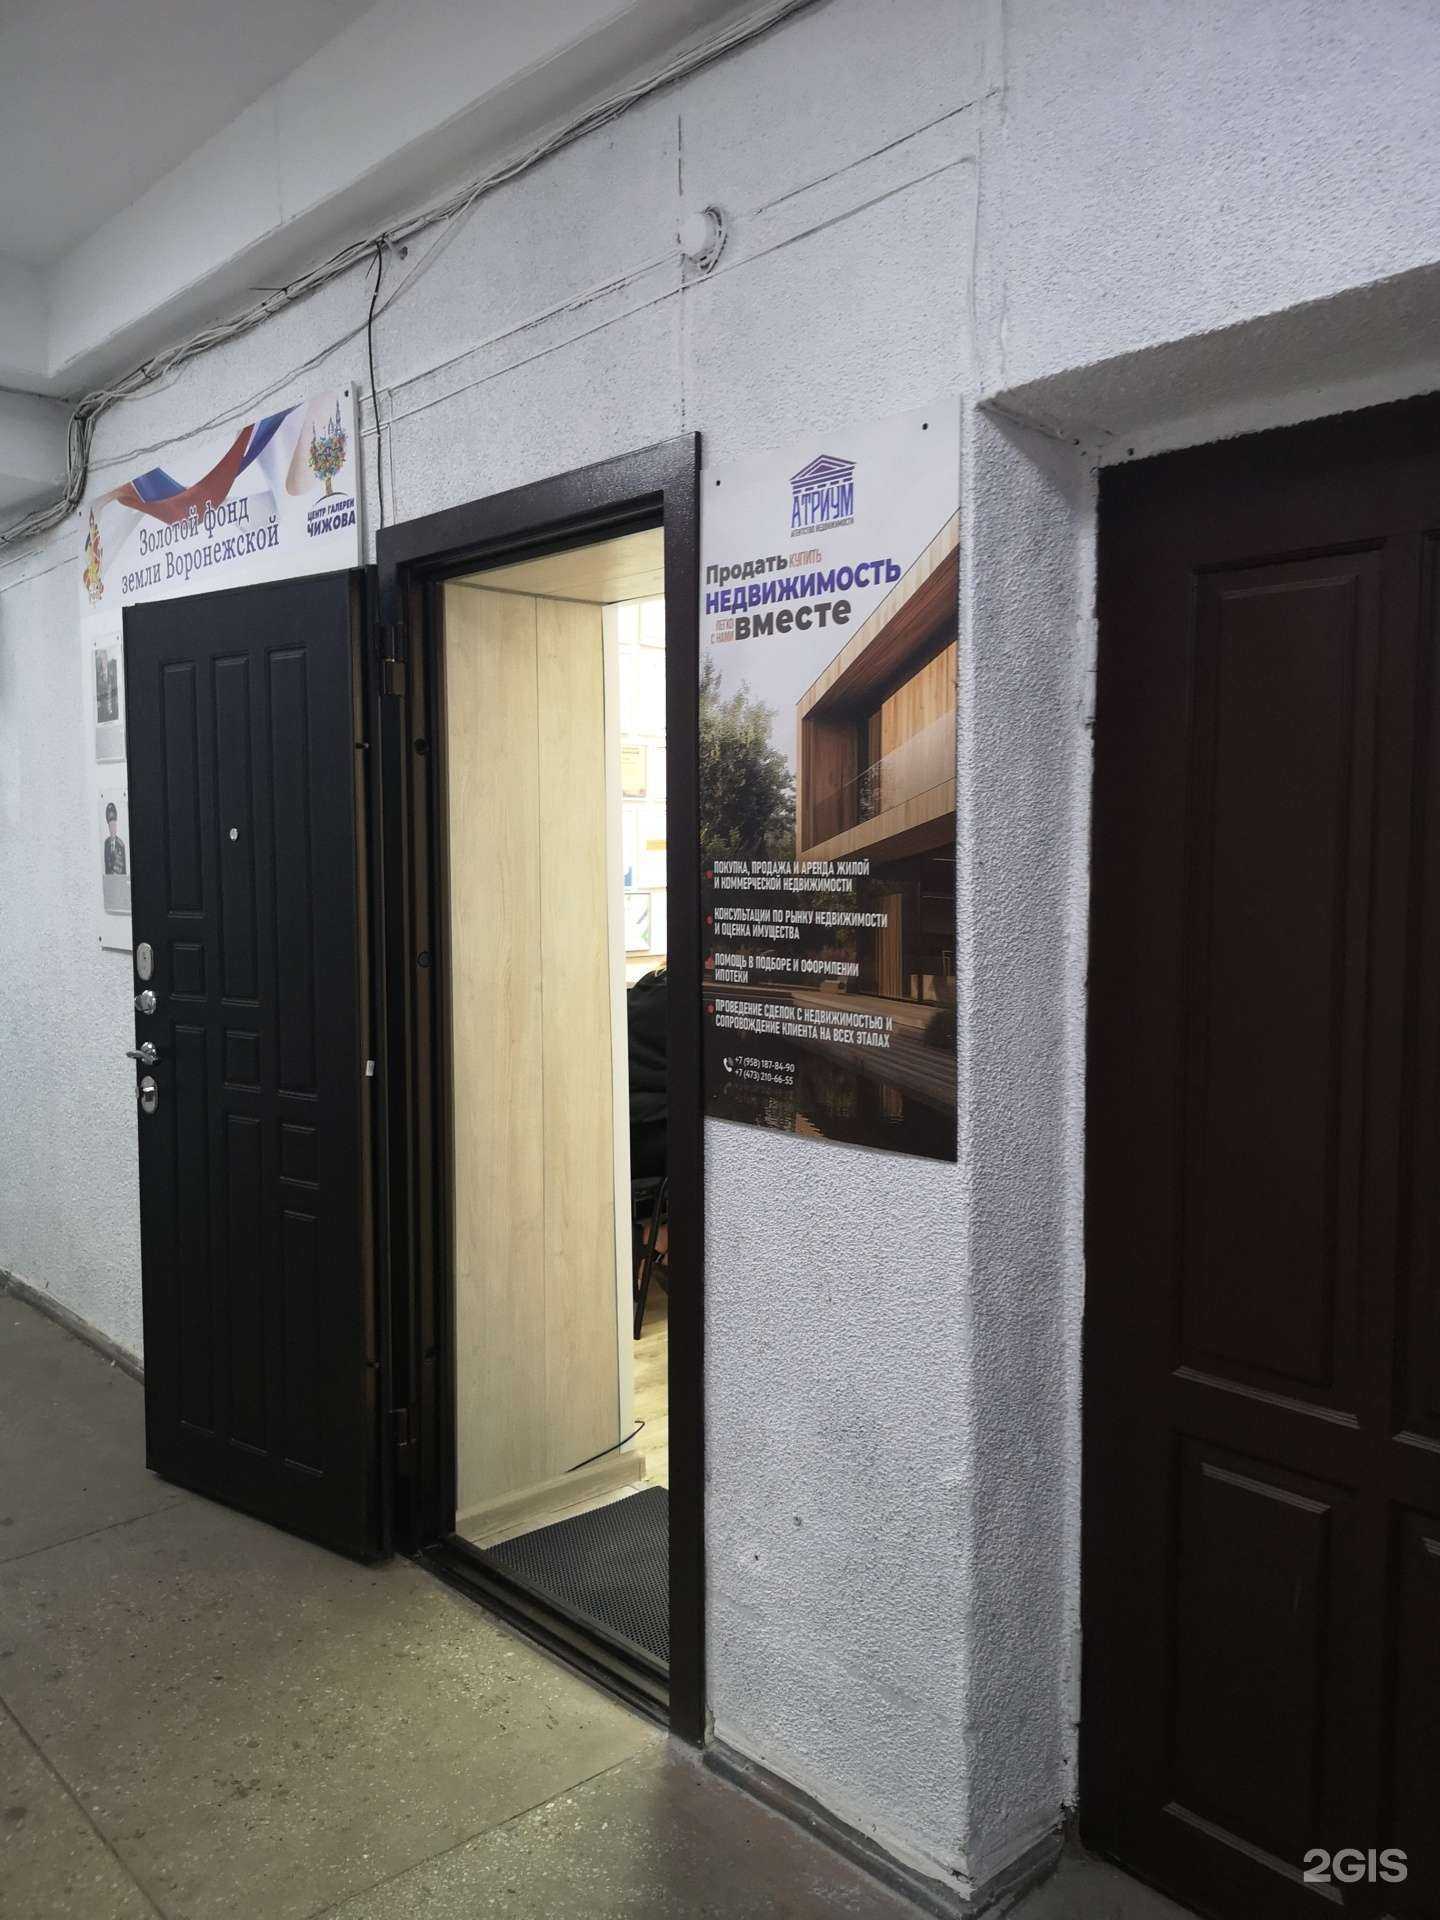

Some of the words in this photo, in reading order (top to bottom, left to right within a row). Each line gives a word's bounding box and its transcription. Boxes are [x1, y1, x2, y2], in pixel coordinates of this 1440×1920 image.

[790, 482, 854, 529] АТРИУМ
[139, 508, 199, 556] Золотой
[203, 497, 249, 540] фонд
[307, 510, 356, 537] ЧИЖОВА
[121, 562, 161, 594] земли
[166, 515, 280, 579] Воронежской
[706, 555, 788, 587] Продать
[789, 549, 822, 568] КУПИТЬ
[705, 558, 902, 614] НЕДВИЖИМОСТЬ
[735, 599, 852, 640] вместе
[714, 860, 750, 876] ПОКУПКА,
[751, 861, 791, 876] ПРОДАЖА
[793, 861, 800, 874] И
[801, 861, 834, 877] АРЕНДА
[836, 859, 870, 876] ЖИЛОЙ
[714, 876, 720, 889] И
[721, 875, 781, 890] КОММЕРЧЕСКОЙ
[783, 877, 853, 892] НЕДВИЖИМОСТИ
[714, 907, 771, 923] КОНСУЛЬТАЦИИ
[773, 909, 783, 922] ПО
[785, 910, 813, 924] РЫНКУ
[815, 911, 888, 928] НЕДВИЖИМОСТИ
[714, 922, 720, 935] И
[721, 923, 751, 938] ОЦЕНКА
[752, 924, 800, 940] ИМУЩЕСТВА
[715, 953, 747, 969] ПОМОЩЬ
[748, 956, 754, 969] В
[755, 956, 792, 972] ПОДБОРЕ
[793, 959, 799, 972] И
[800, 959, 859, 976] ОФОРМЛЕНИИ
[715, 969, 749, 983] ИПОТЕКИ
[715, 999, 763, 1016] ПРОВЕДЕНИЕ
[764, 1003, 795, 1020] СДЕЛОК
[796, 1007, 803, 1021] С
[804, 1008, 883, 1030] НЕДВИЖИМОСТЬЮ
[886, 1016, 893, 1031] И
[715, 1014, 780, 1035] СОПРОВОЖДЕНИЕ
[782, 1021, 818, 1040] КЛИЕНТА
[820, 1027, 831, 1041] НА
[833, 1029, 855, 1044] ВСЕХ
[856, 1032, 890, 1048] ЭТАПАХ
[735, 1056, 743, 1064] +7
[735, 1068, 743, 1077] +7
[743, 1070, 760, 1082] (473)
